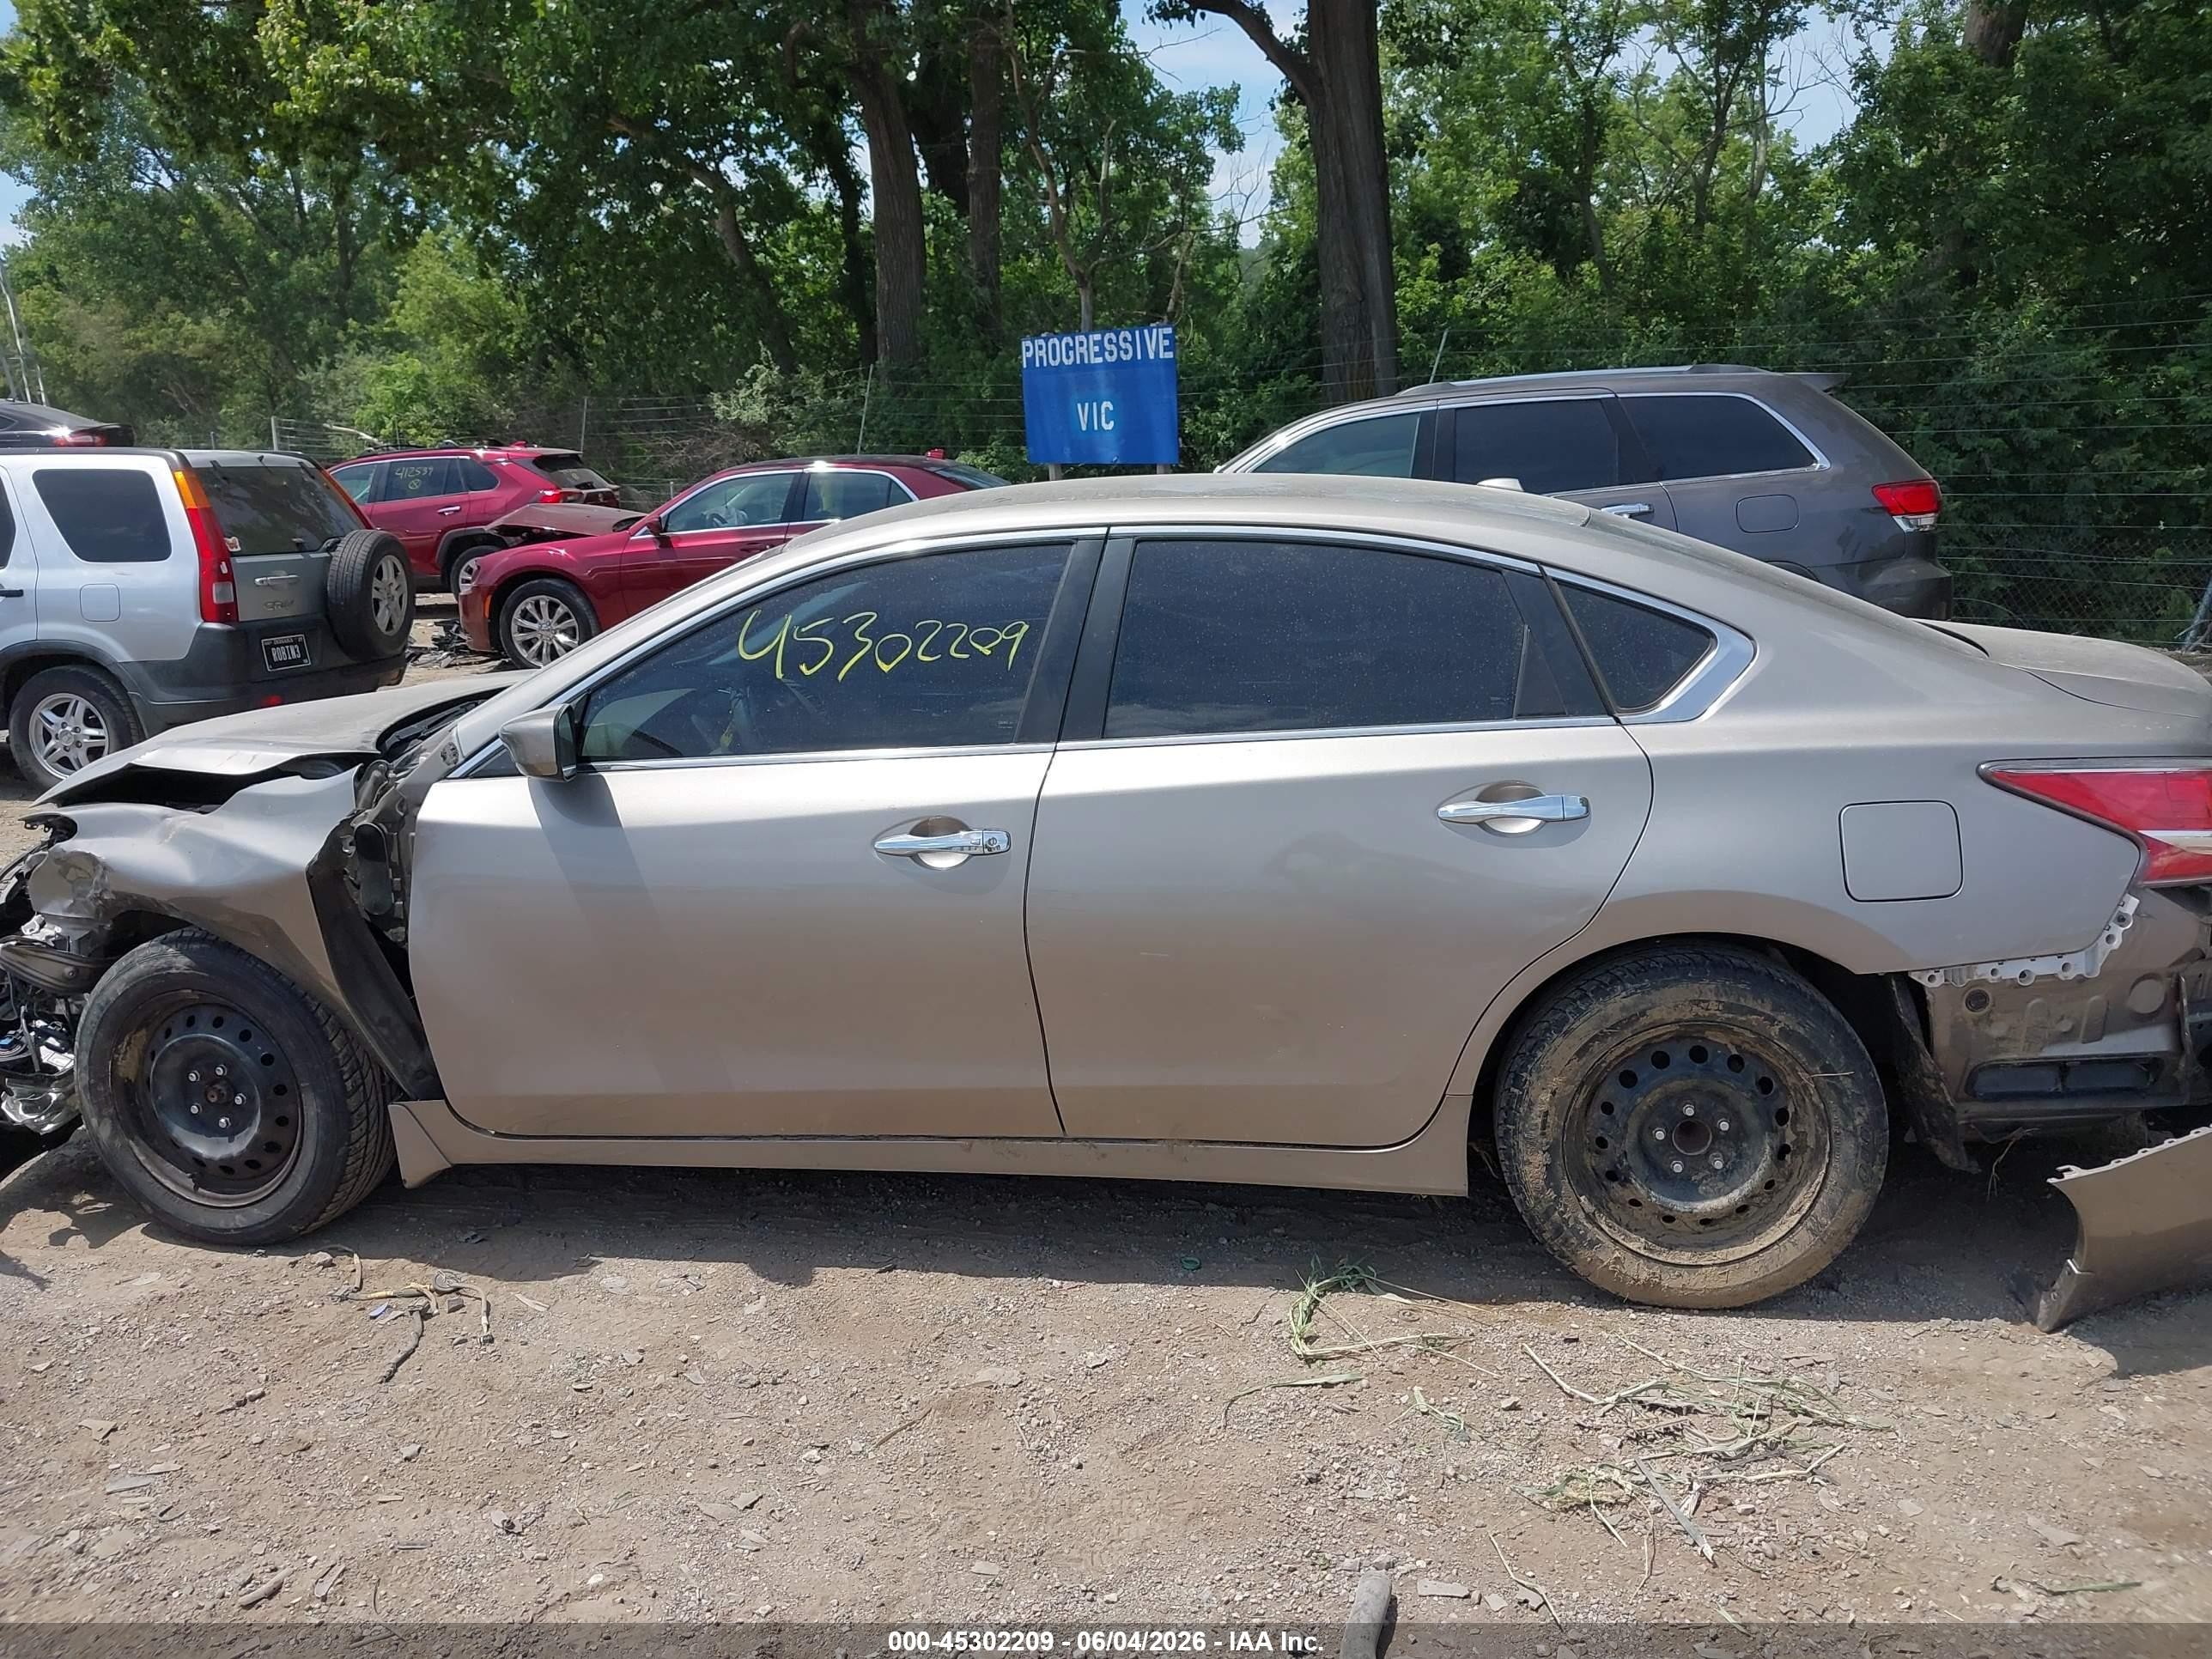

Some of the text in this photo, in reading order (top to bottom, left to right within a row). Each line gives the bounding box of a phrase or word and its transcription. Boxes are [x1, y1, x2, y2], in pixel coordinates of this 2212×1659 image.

[1022, 327, 1174, 368] PROGRESSIVE
[1077, 401, 1115, 431] VIC
[738, 609, 1030, 683] 45302209
